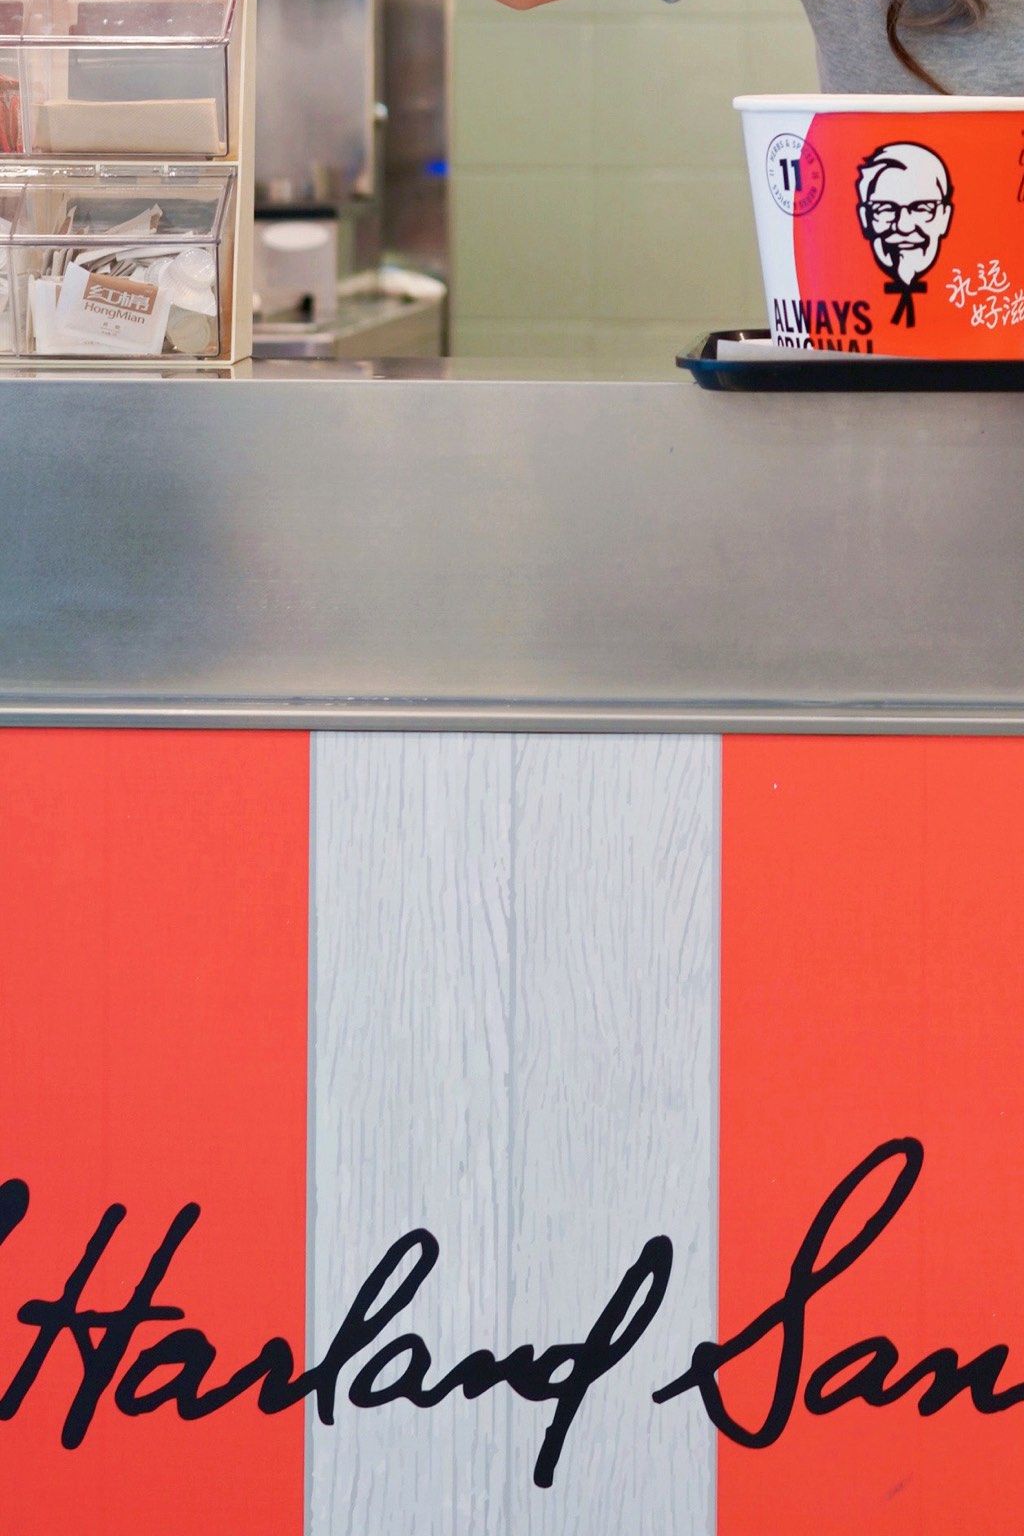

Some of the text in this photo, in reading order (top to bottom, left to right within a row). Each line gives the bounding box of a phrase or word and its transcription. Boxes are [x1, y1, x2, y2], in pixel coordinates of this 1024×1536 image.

[779, 158, 802, 192] 11
[946, 260, 1010, 308] 永远
[84, 302, 145, 325] HongMian
[773, 298, 873, 335] ALWAYS
[0, 1203, 673, 1488] Harland
